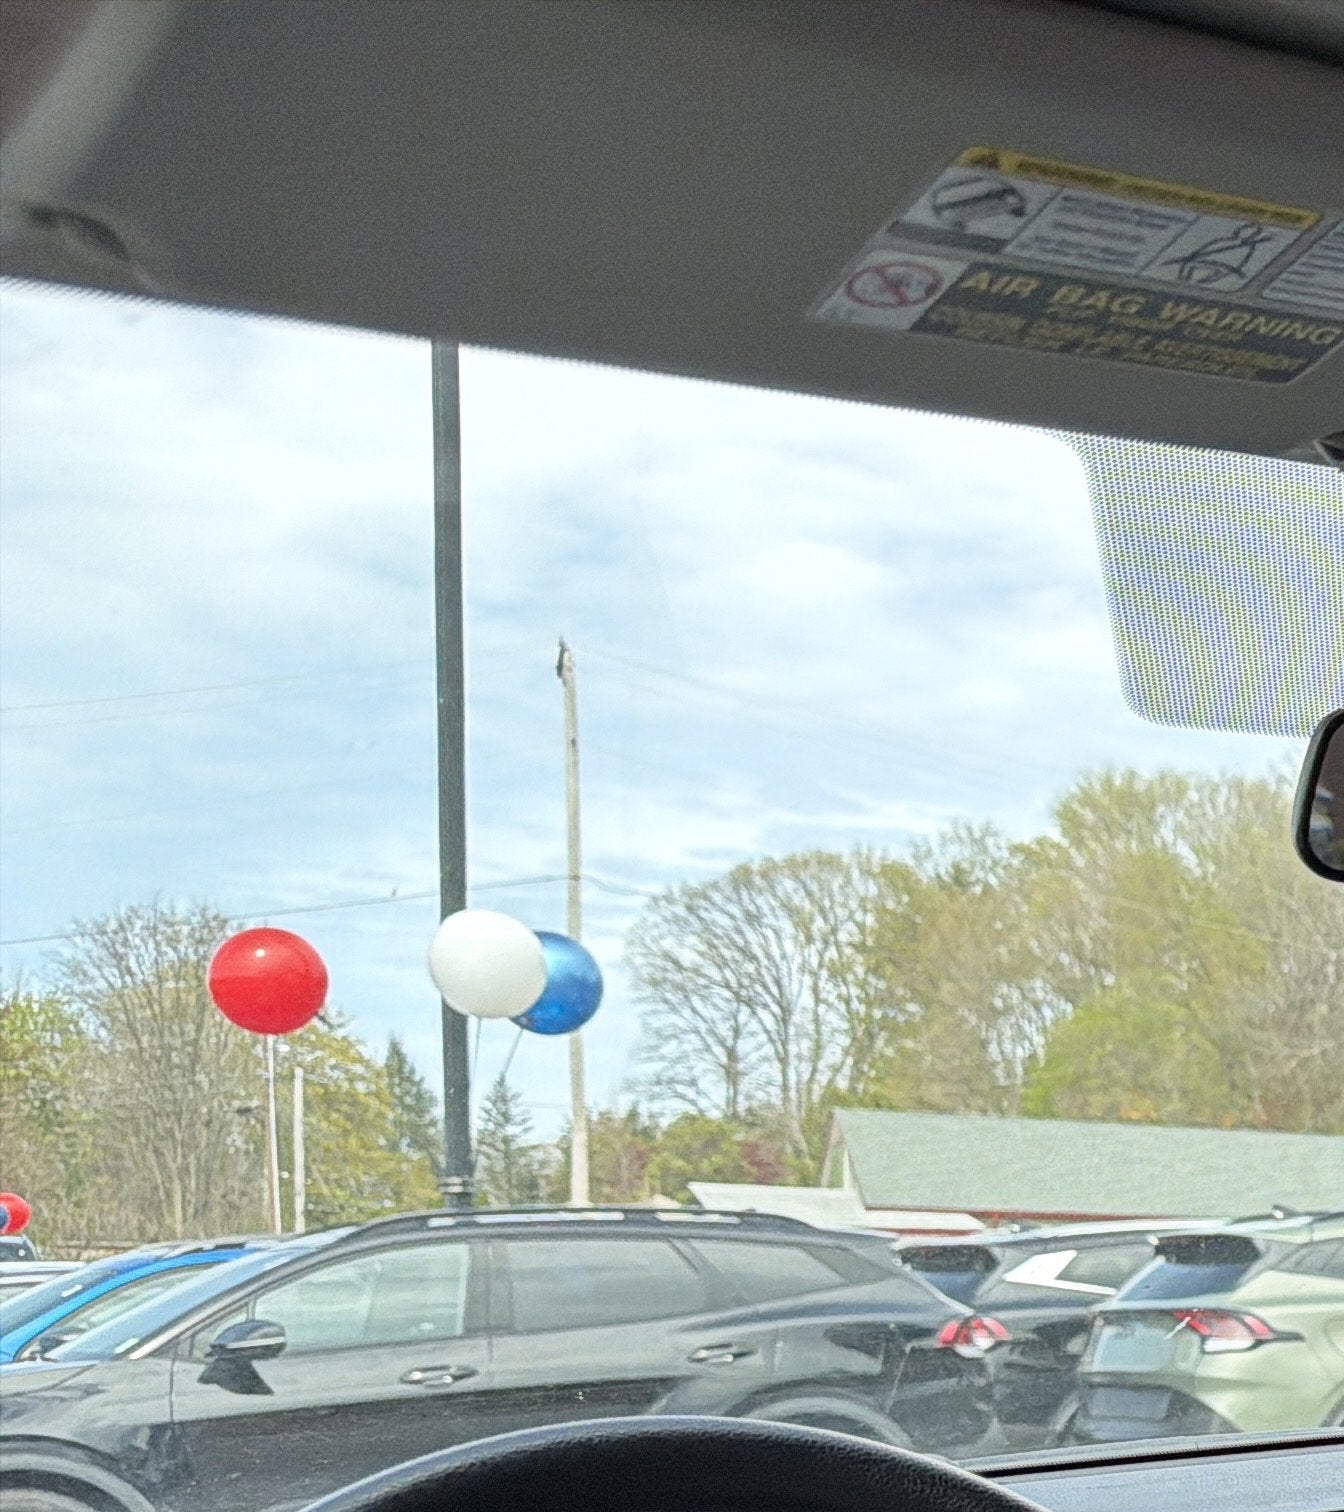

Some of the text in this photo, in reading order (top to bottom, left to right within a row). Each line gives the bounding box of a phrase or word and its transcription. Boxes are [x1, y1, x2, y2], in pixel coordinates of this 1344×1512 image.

[959, 271, 1041, 299] AIR
[1051, 285, 1146, 315] BAG
[1158, 301, 1344, 344] WARNING
